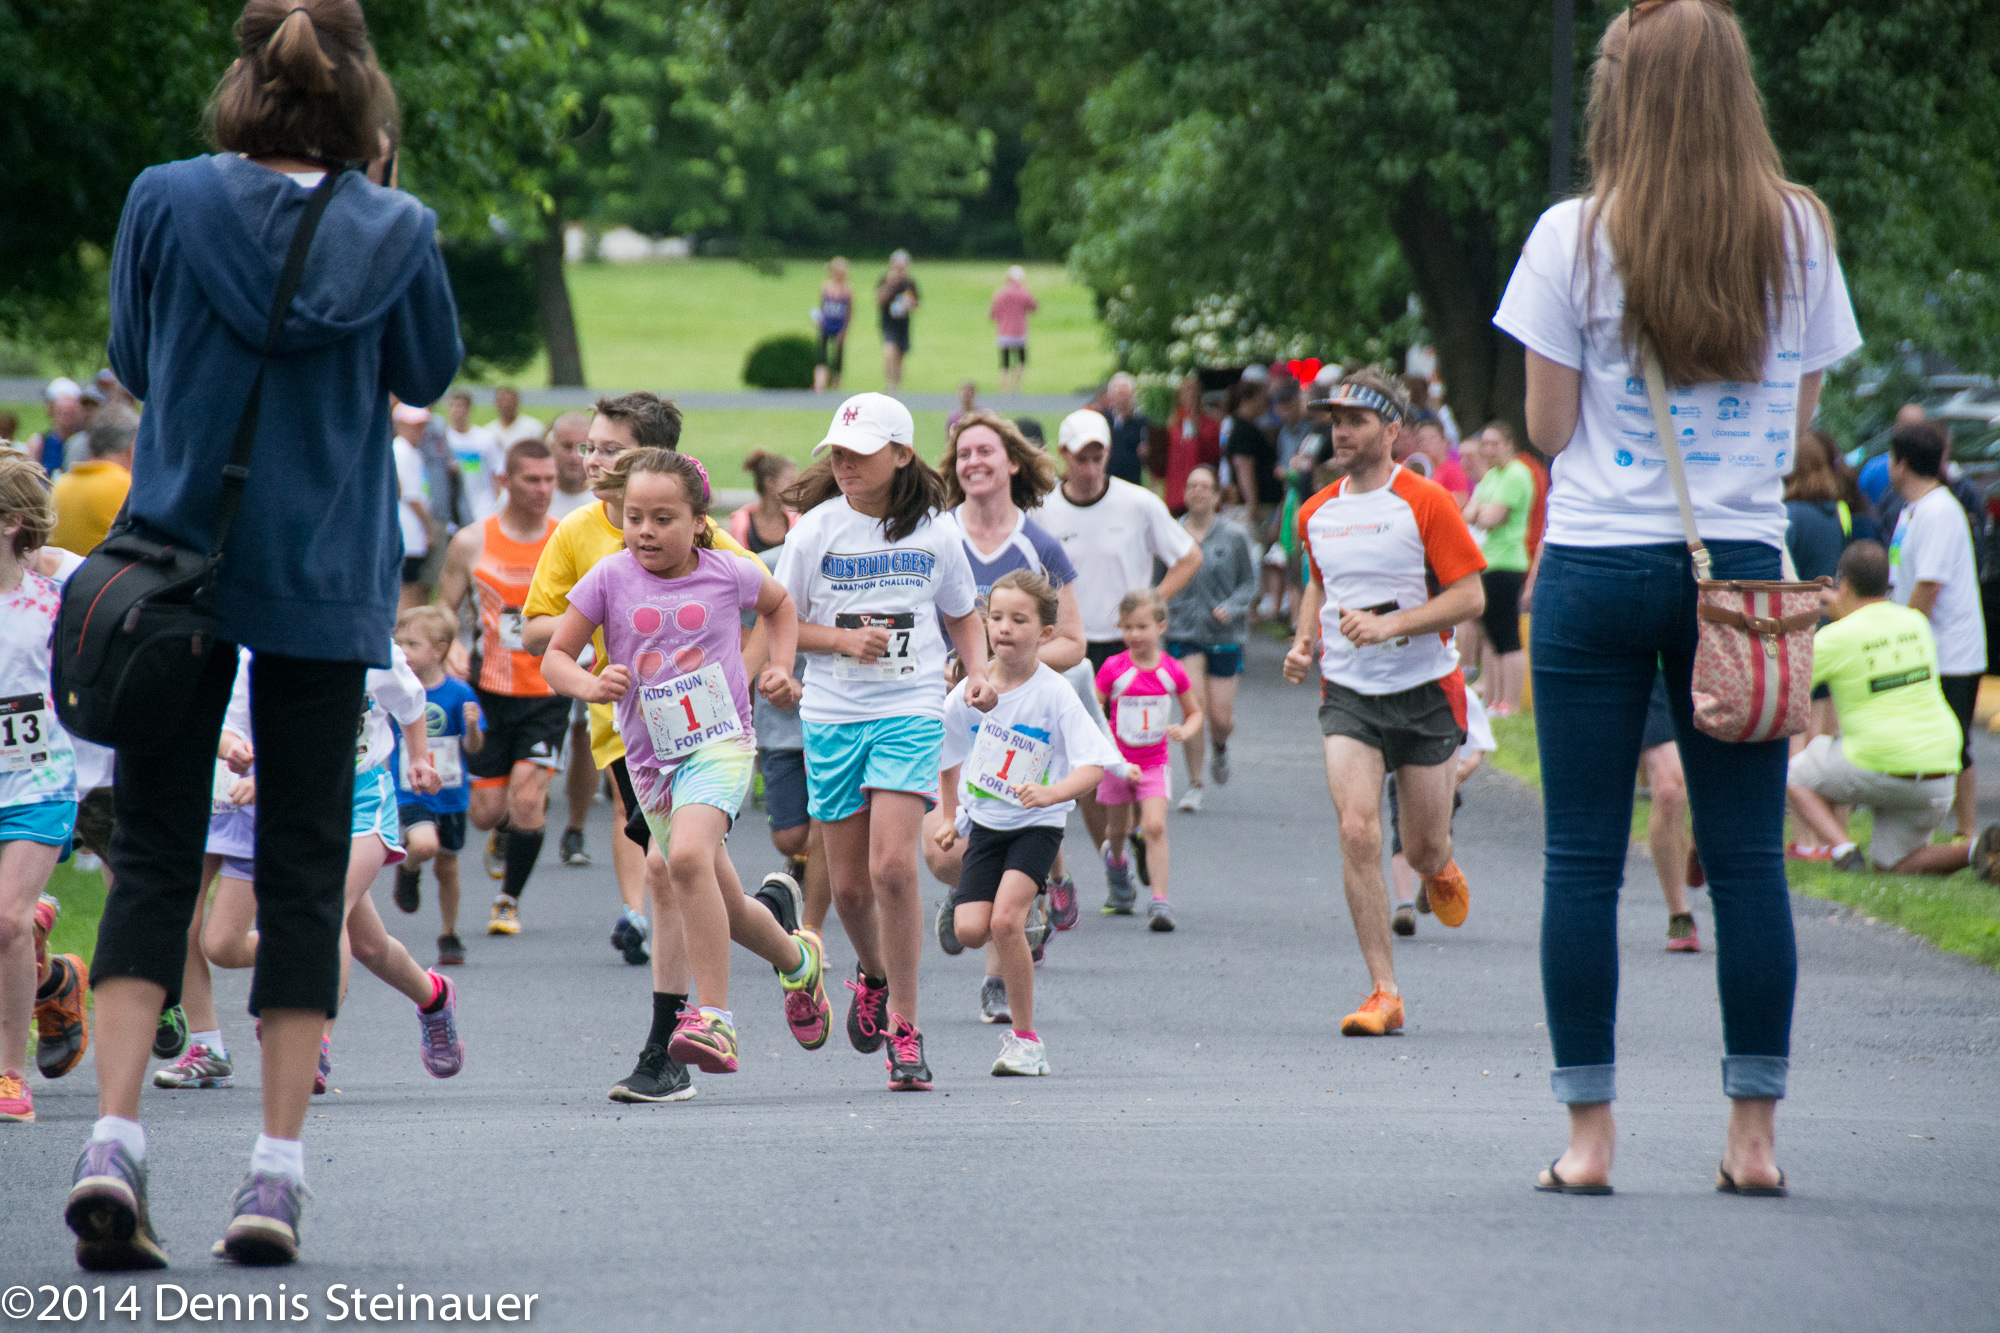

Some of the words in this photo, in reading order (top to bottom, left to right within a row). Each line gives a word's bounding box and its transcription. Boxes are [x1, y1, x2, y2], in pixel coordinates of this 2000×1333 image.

[821, 555, 855, 578] KIDS
[891, 552, 935, 578] CREST
[831, 581, 876, 591] MARATHON
[879, 577, 924, 588] CHALLENGE
[644, 686, 673, 701] KIDS
[675, 675, 703, 694] RUN
[679, 695, 701, 732] 1
[1142, 709, 1149, 731] 1
[675, 732, 703, 750] FOR
[706, 720, 734, 739] FUN
[984, 722, 1010, 742] KIDS
[1010, 734, 1036, 753] RUN
[996, 749, 1016, 780] 1
[979, 773, 1004, 792] FOR
